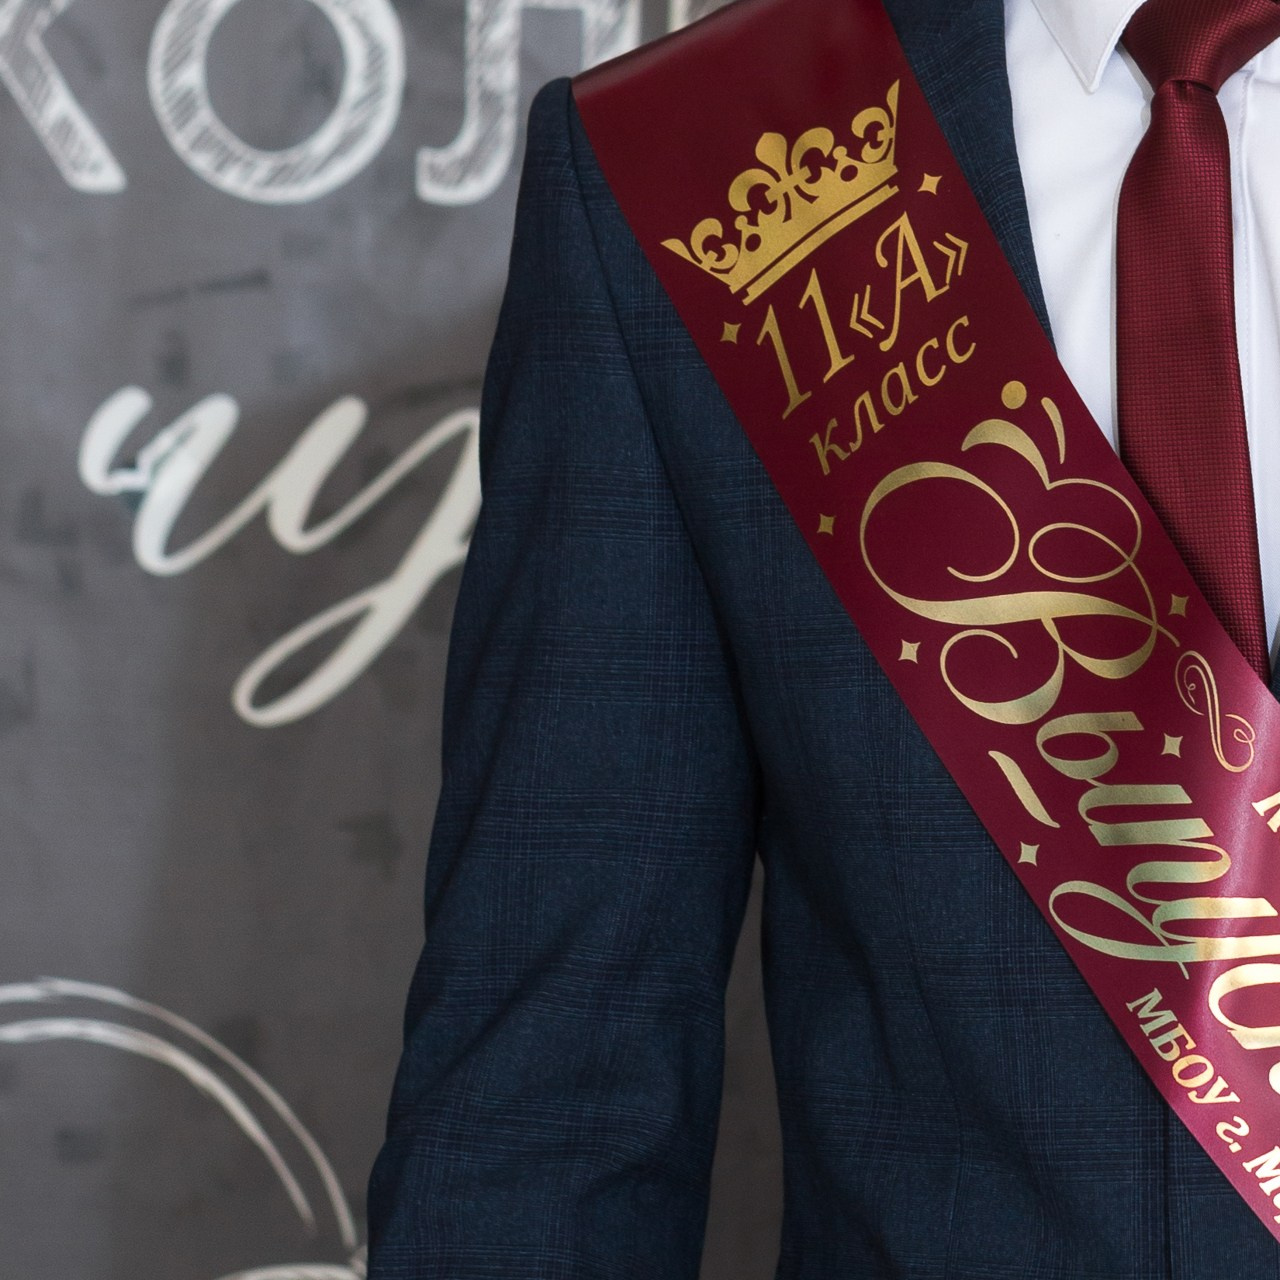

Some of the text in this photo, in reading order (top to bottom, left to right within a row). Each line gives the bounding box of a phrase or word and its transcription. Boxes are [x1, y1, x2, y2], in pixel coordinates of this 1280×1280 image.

[809, 315, 977, 475] класс
[1126, 987, 1241, 1107] МБОУ
[1215, 1114, 1242, 1152] г.
